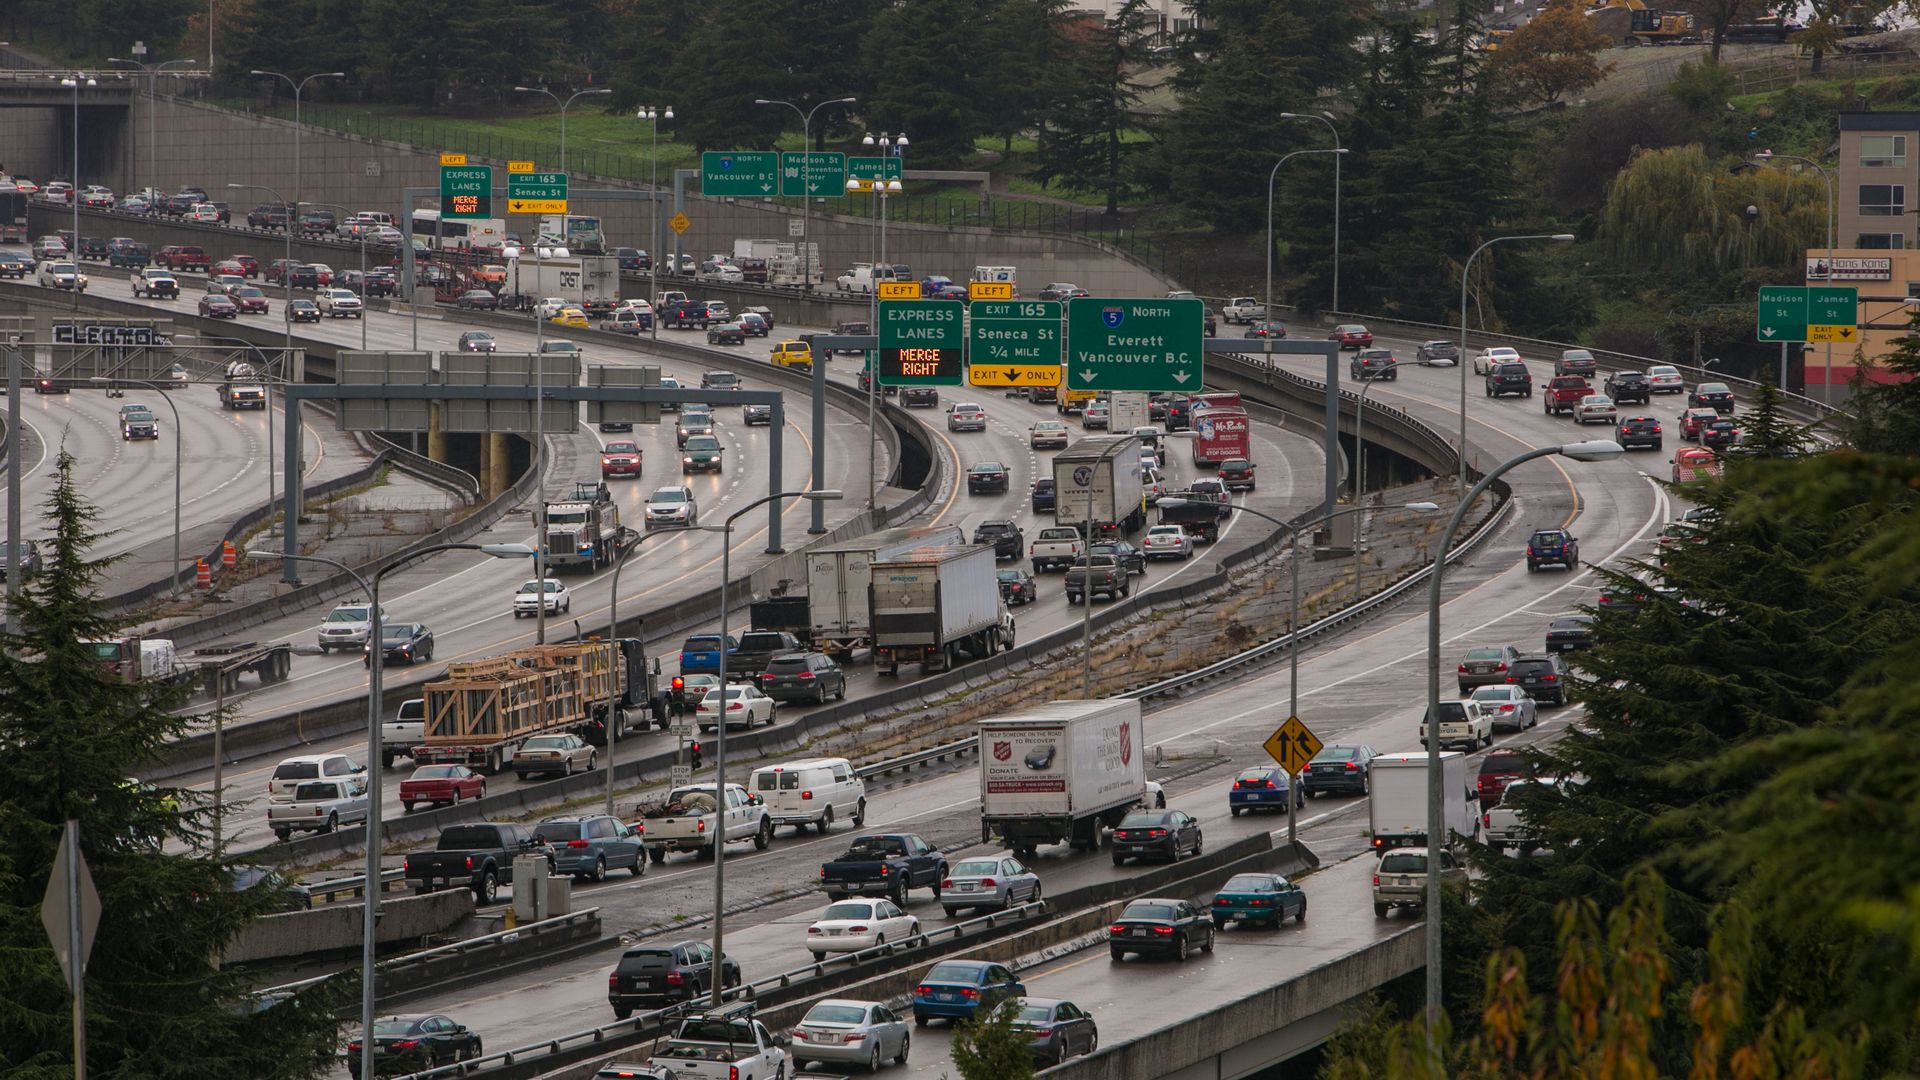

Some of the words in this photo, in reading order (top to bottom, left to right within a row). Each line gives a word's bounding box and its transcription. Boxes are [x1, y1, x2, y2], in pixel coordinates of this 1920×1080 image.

[893, 146, 901, 155] H
[788, 156, 825, 164] Madson
[828, 156, 838, 164] St
[853, 162, 882, 171] James
[446, 171, 486, 179] EXPRESS
[540, 175, 556, 183] 165
[515, 188, 546, 196] Seneca
[453, 196, 478, 204] MERGE
[455, 204, 477, 213] RIGHT
[886, 286, 913, 294] LEFT
[977, 286, 1005, 295] LEFT
[1762, 295, 1803, 303] Madison
[1817, 295, 1849, 303] James
[986, 305, 1010, 314] EXIT
[1019, 304, 1046, 317] 165
[1132, 306, 1170, 318] NORTH
[888, 310, 954, 321] EXPRESS
[1109, 312, 1117, 323] 5
[896, 328, 945, 339] LANES
[978, 328, 1028, 340] Seneca
[1038, 328, 1054, 340] St
[1107, 335, 1163, 346] Everett
[899, 348, 941, 361] MERGE
[990, 345, 1008, 358] 3/4
[1015, 348, 1040, 357] MILE
[1079, 351, 1157, 363] Vancouver
[1165, 352, 1192, 363] B.C.
[902, 362, 939, 375] RIGHT
[974, 371, 998, 379] EXIT
[1026, 371, 1056, 379] ONLY
